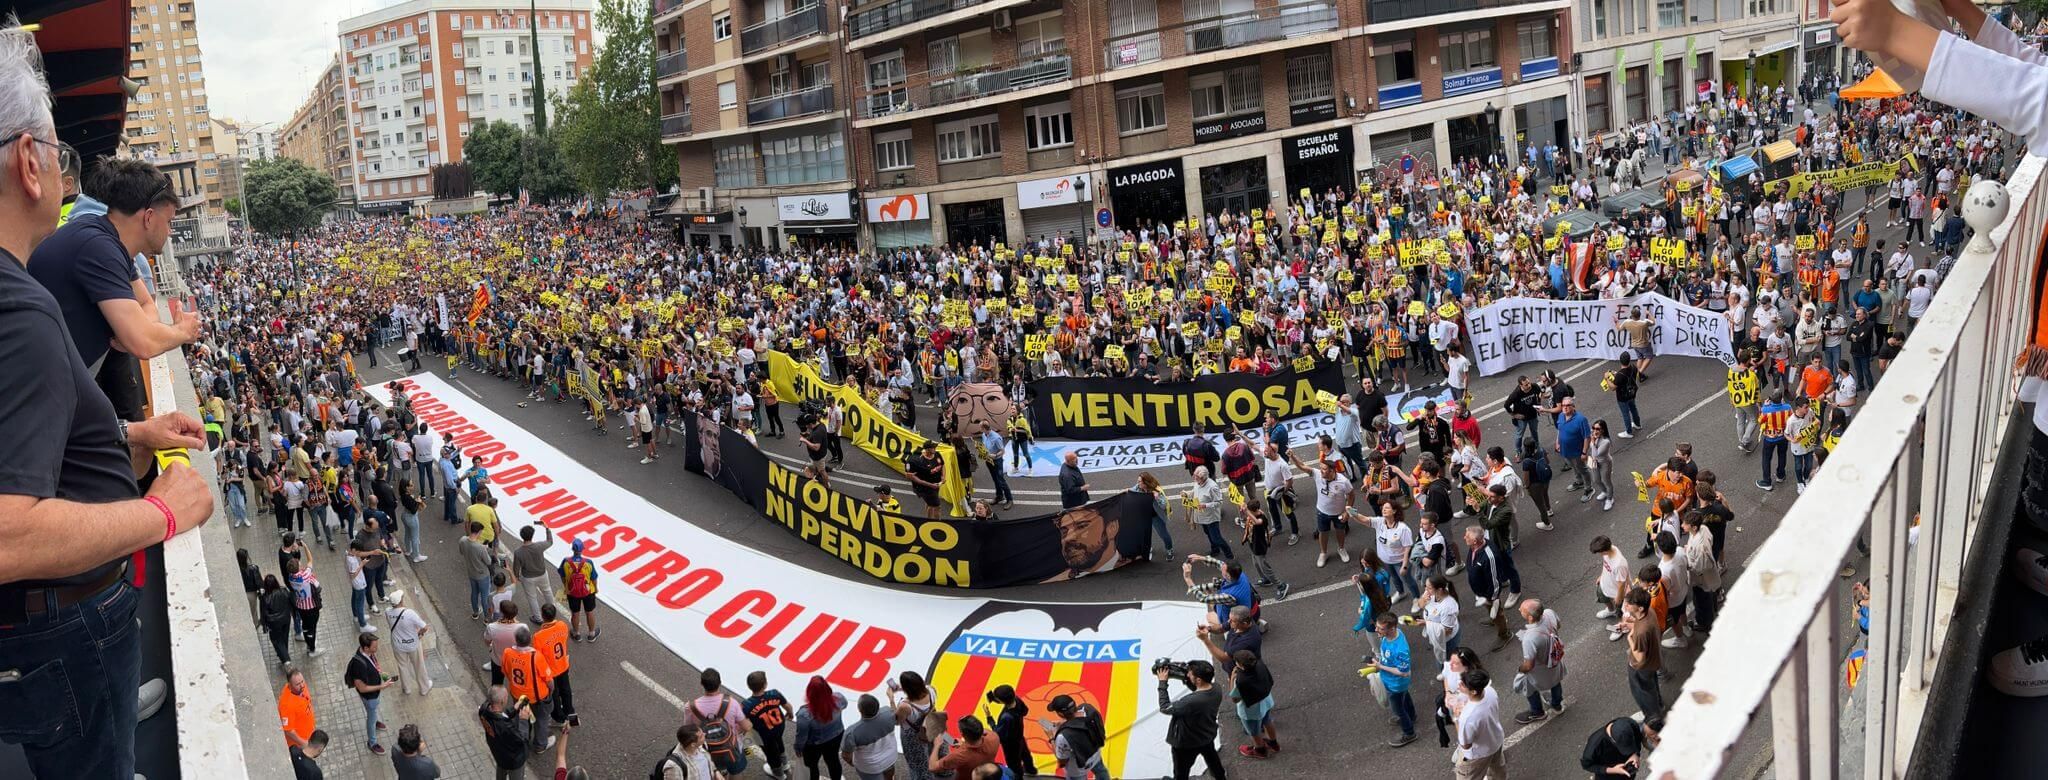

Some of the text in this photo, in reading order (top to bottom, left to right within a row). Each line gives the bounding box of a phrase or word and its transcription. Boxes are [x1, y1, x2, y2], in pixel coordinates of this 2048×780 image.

[1444, 74, 1490, 90] Solmar Finance
[1195, 117, 1264, 137] MORENO ASOCIADOS
[1297, 133, 1339, 148] ESCUELA DE
[1298, 143, 1339, 159] ESPAÑOL
[1115, 167, 1175, 187] LA PAGODA
[1404, 240, 1422, 250] LIM
[1657, 237, 1678, 249] LIM
[1653, 252, 1686, 266] HOME
[1216, 278, 1233, 286] LIM
[1330, 319, 1342, 327] GO
[1471, 314, 1492, 335] EL
[1674, 307, 1719, 333] FORA
[1028, 334, 1048, 343] LIM
[1478, 342, 1501, 362] EL
[1576, 330, 1598, 350] ES
[1732, 382, 1746, 391] GO
[1051, 379, 1319, 428] MENTIROSA
[489, 463, 553, 497] DE
[768, 460, 958, 552] NI OLVIDO
[765, 488, 971, 588] NI PERDÓN
[519, 487, 724, 610] NUESTRO
[553, 641, 565, 660] 9
[703, 589, 907, 693] CLUB
[965, 636, 1117, 660] VALENCIA
[512, 668, 525, 686] 8
[758, 707, 784, 730] 10
